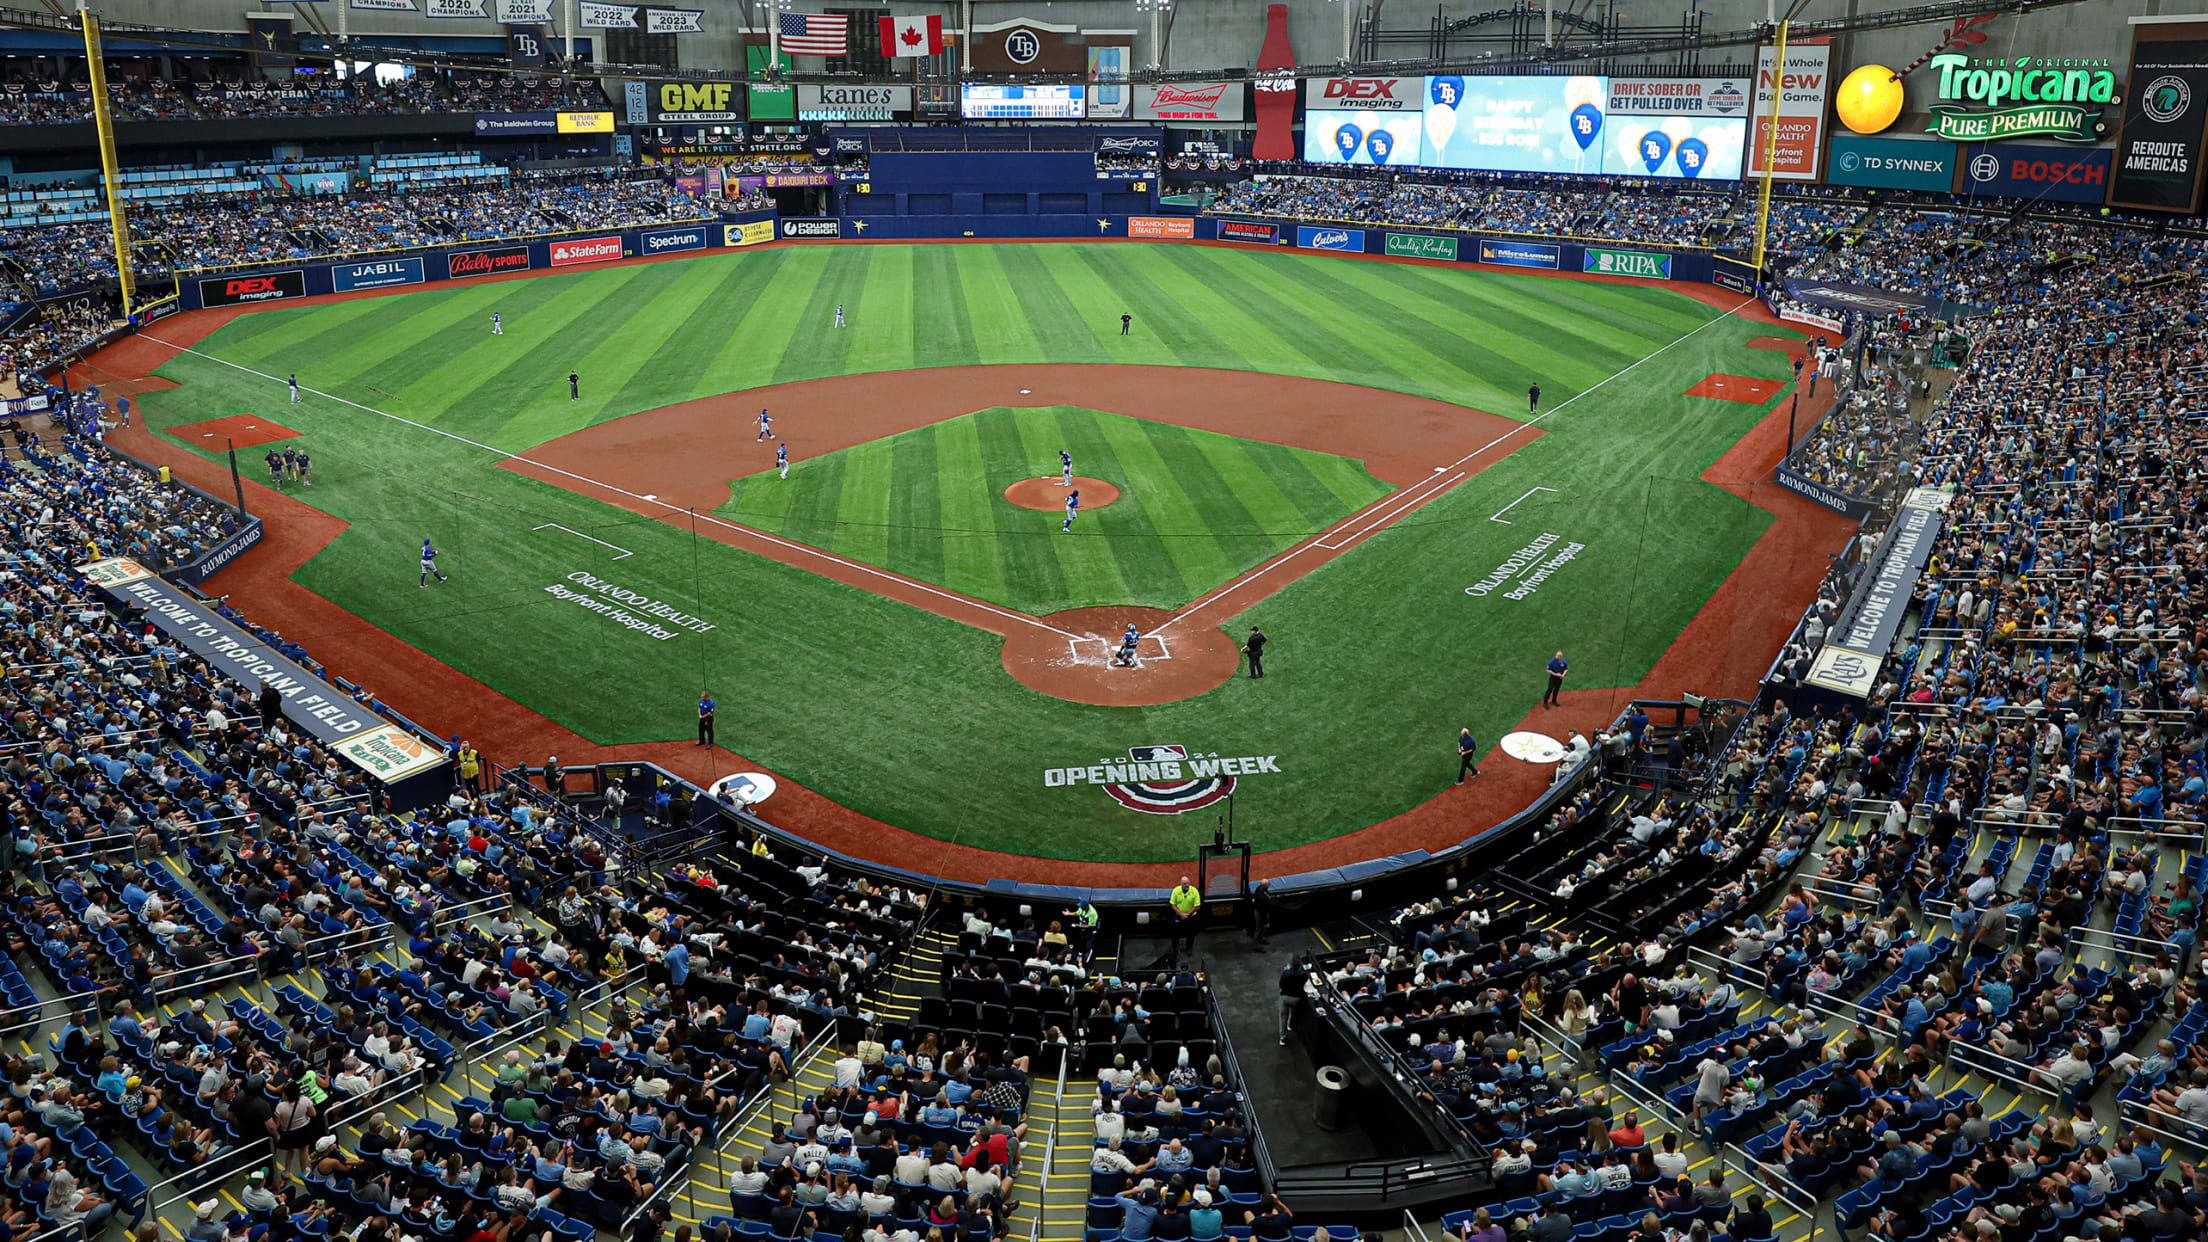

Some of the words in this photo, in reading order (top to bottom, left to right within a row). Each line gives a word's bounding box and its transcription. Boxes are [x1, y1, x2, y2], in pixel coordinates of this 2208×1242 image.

[431, 8, 480, 16] CHAMPIONS
[440, 0, 470, 9] 2020
[509, 5, 536, 13] 2021
[594, 10, 623, 19] 2022
[659, 16, 687, 25] 2023
[1789, 58, 1823, 67] Whole
[1973, 58, 2006, 67] THE
[2036, 58, 2109, 67] ORIGINAL
[1760, 69, 1822, 89] New
[1930, 53, 2115, 107] Tropicana
[628, 85, 642, 94] 42
[819, 85, 892, 104] kane's
[1323, 79, 1399, 98] DEX
[1614, 83, 1646, 96] DRIVE
[1647, 83, 1683, 96] SOBER
[1685, 84, 1701, 96] OR
[631, 99, 642, 108] 12
[660, 83, 732, 111] GMF
[1158, 90, 1220, 104] Budweiser
[1340, 98, 1403, 109] imaging
[1610, 97, 1631, 109] GET
[1632, 97, 1673, 110] PULLED
[1674, 97, 1702, 110] OVER
[1783, 92, 1823, 102] Game.
[489, 120, 503, 128] The
[504, 119, 532, 128] Baldwin
[533, 120, 556, 128] Group
[630, 112, 644, 122] 66
[698, 112, 732, 120] GROUP
[1940, 115, 1988, 136] PURE
[1991, 112, 2083, 134] PREMIUM
[662, 146, 676, 154] WE
[698, 145, 711, 153] ST.
[750, 143, 802, 151] STPETE.ORG
[2131, 140, 2187, 158] REROUTE
[1863, 157, 1881, 169] TD
[1885, 157, 1944, 173] SYNNEX
[2011, 159, 2105, 185] BOSCH
[2125, 155, 2189, 173] AMERICAS
[778, 176, 808, 186] DAIQUIRI
[810, 175, 828, 185] DECK
[1131, 219, 1166, 227] ORLANDO
[1135, 226, 1161, 234] HEALTH
[1225, 223, 1271, 234] AMERICAN
[649, 233, 697, 249] Spectrum
[1312, 230, 1350, 247] Culver's
[1389, 235, 1420, 254] Quality
[1422, 238, 1453, 257] Roofing
[1498, 249, 1556, 260] MicroLumen
[352, 262, 406, 277] JABIL
[451, 253, 496, 273] Bally
[495, 253, 527, 267] SPORTS
[1614, 254, 1658, 275] RIPA
[225, 276, 278, 296] DEX
[239, 288, 284, 300] imaging
[1779, 472, 1819, 503] RAYMOND
[1817, 491, 1847, 513] JAMES
[1906, 509, 1931, 532] FIELD
[200, 541, 238, 577] RAYMOND
[236, 528, 262, 555] JAMES
[1884, 527, 1921, 582] TROPICANA
[1464, 558, 1527, 597] ORLANDO
[1511, 532, 1561, 561] HEALTH
[1502, 569, 1555, 600] Bayfront
[1540, 541, 1586, 570] Hospital
[1876, 580, 1897, 600] TO
[567, 571, 649, 606] ORLANDO
[643, 600, 717, 633] HEALTH
[544, 583, 613, 613] Bayfront
[604, 608, 680, 641] Hospital
[1846, 590, 1890, 649] WELCOME
[125, 581, 200, 626] WELCOME
[188, 622, 218, 638] TO
[208, 635, 306, 698] TROPICANA
[296, 694, 362, 733] FIELD
[365, 734, 411, 766] Tropicana
[1100, 756, 1127, 764] 20
[1193, 751, 1218, 760] 24
[1044, 762, 1183, 787] OPENING
[1188, 755, 1282, 778] WEEK
